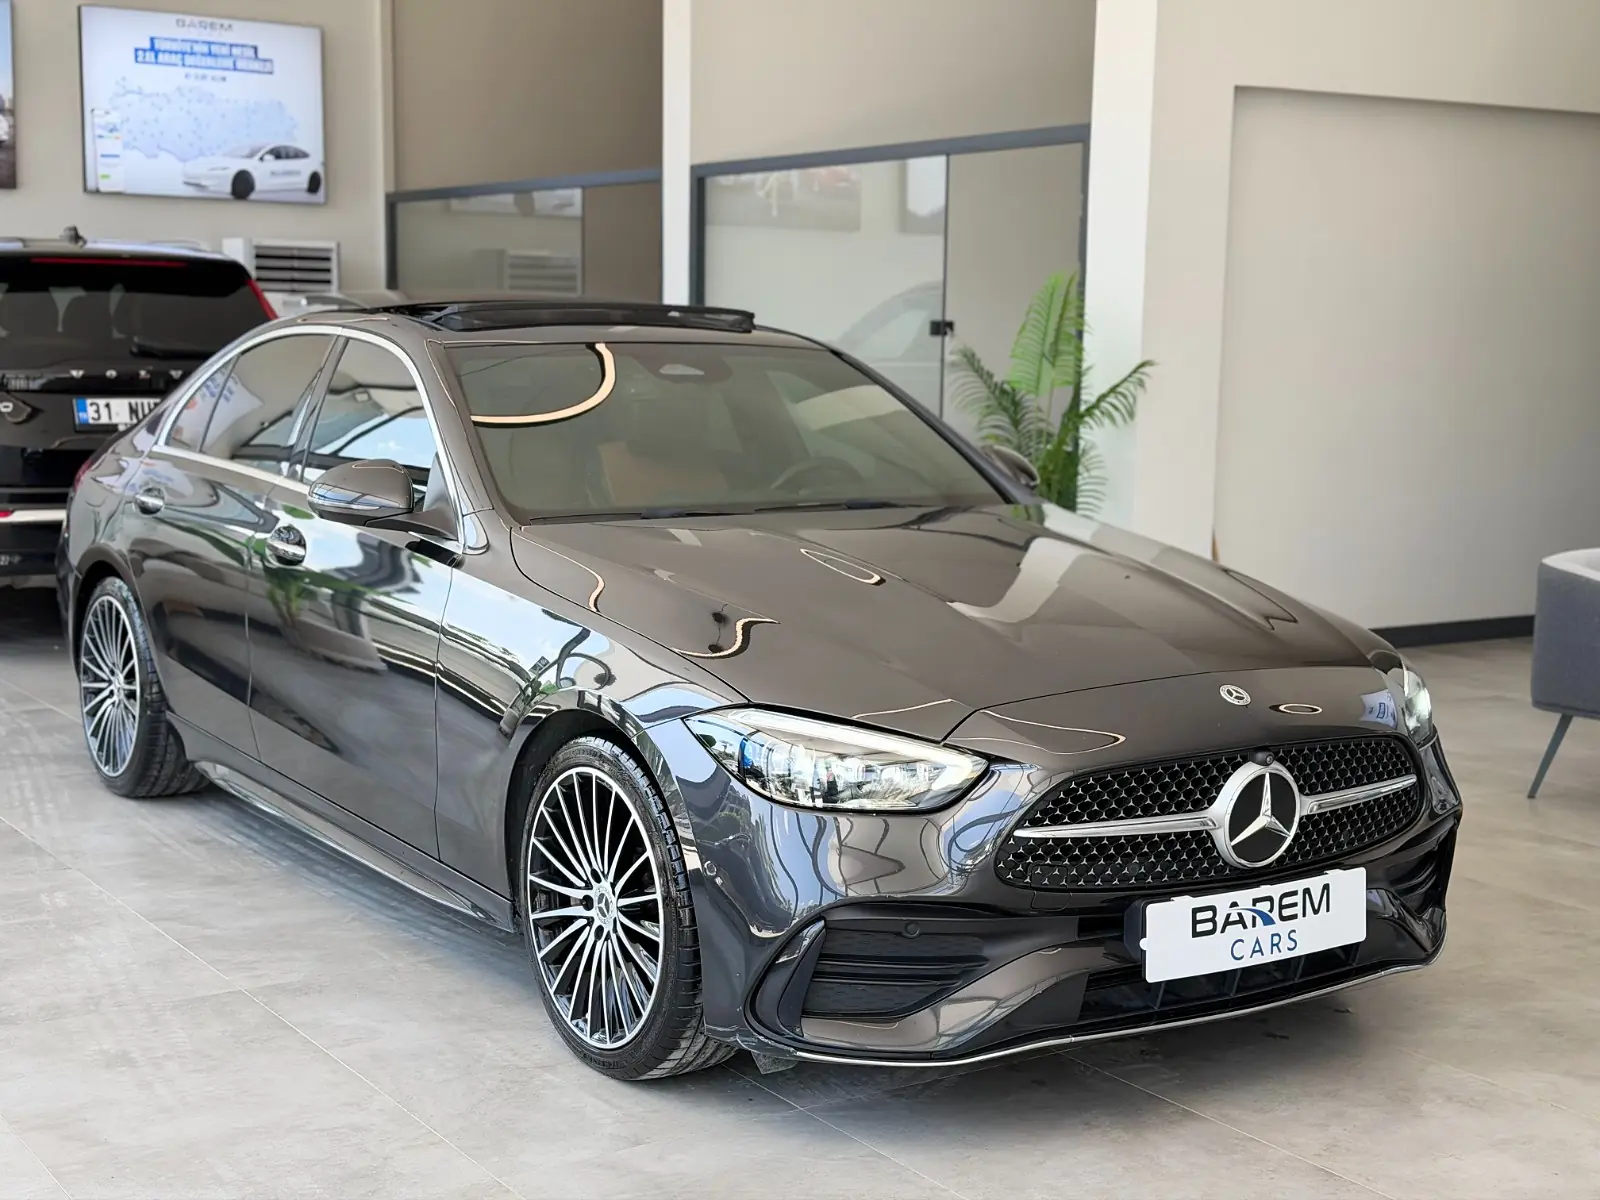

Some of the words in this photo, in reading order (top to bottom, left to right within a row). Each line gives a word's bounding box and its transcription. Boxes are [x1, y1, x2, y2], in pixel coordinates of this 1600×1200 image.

[69, 369, 183, 379] VOLV
[89, 402, 113, 421] 31
[1191, 882, 1330, 938] BAREM
[1230, 929, 1298, 961] CARS
